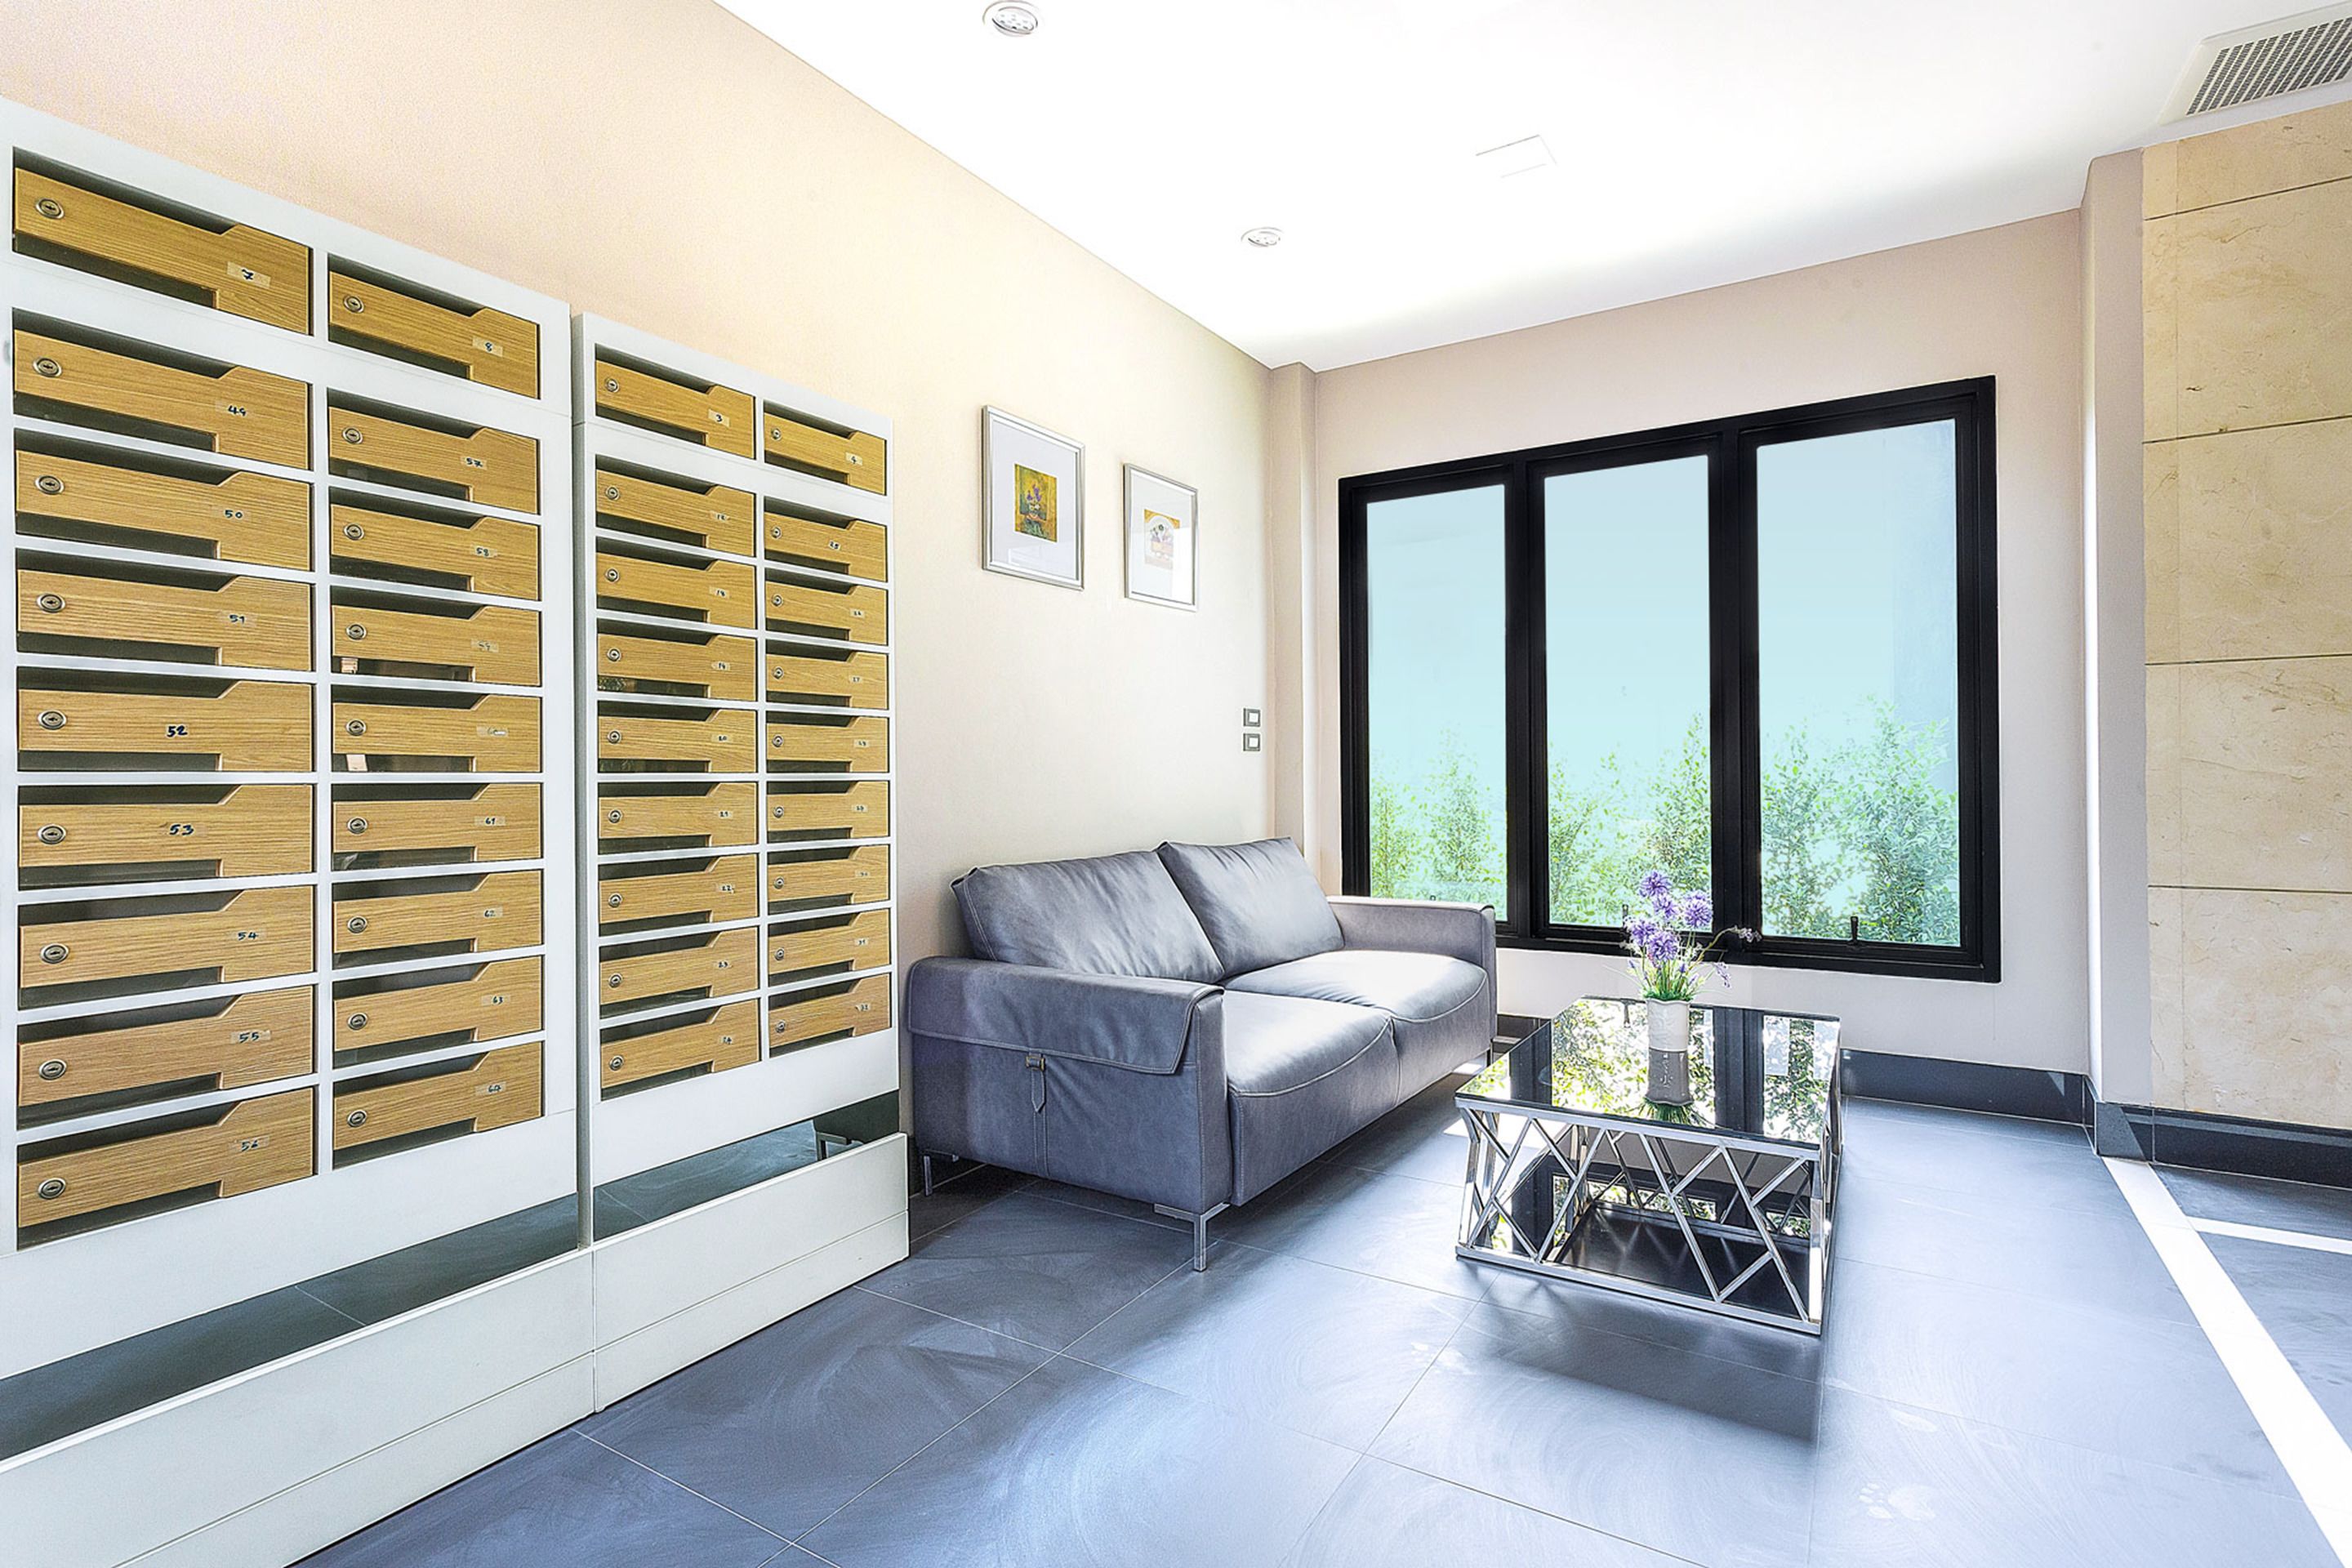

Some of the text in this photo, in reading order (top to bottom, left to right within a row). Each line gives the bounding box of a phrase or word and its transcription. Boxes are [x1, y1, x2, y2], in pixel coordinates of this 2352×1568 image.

[485, 342, 492, 352] 8
[228, 405, 246, 416] 49
[715, 414, 723, 422] 3
[225, 509, 243, 519] 50
[476, 547, 490, 557] 58
[229, 614, 245, 624] 51
[167, 725, 188, 737] 52
[169, 823, 194, 835] 53
[238, 932, 258, 941] 54
[492, 996, 503, 1004] 63
[239, 1031, 260, 1044] 55
